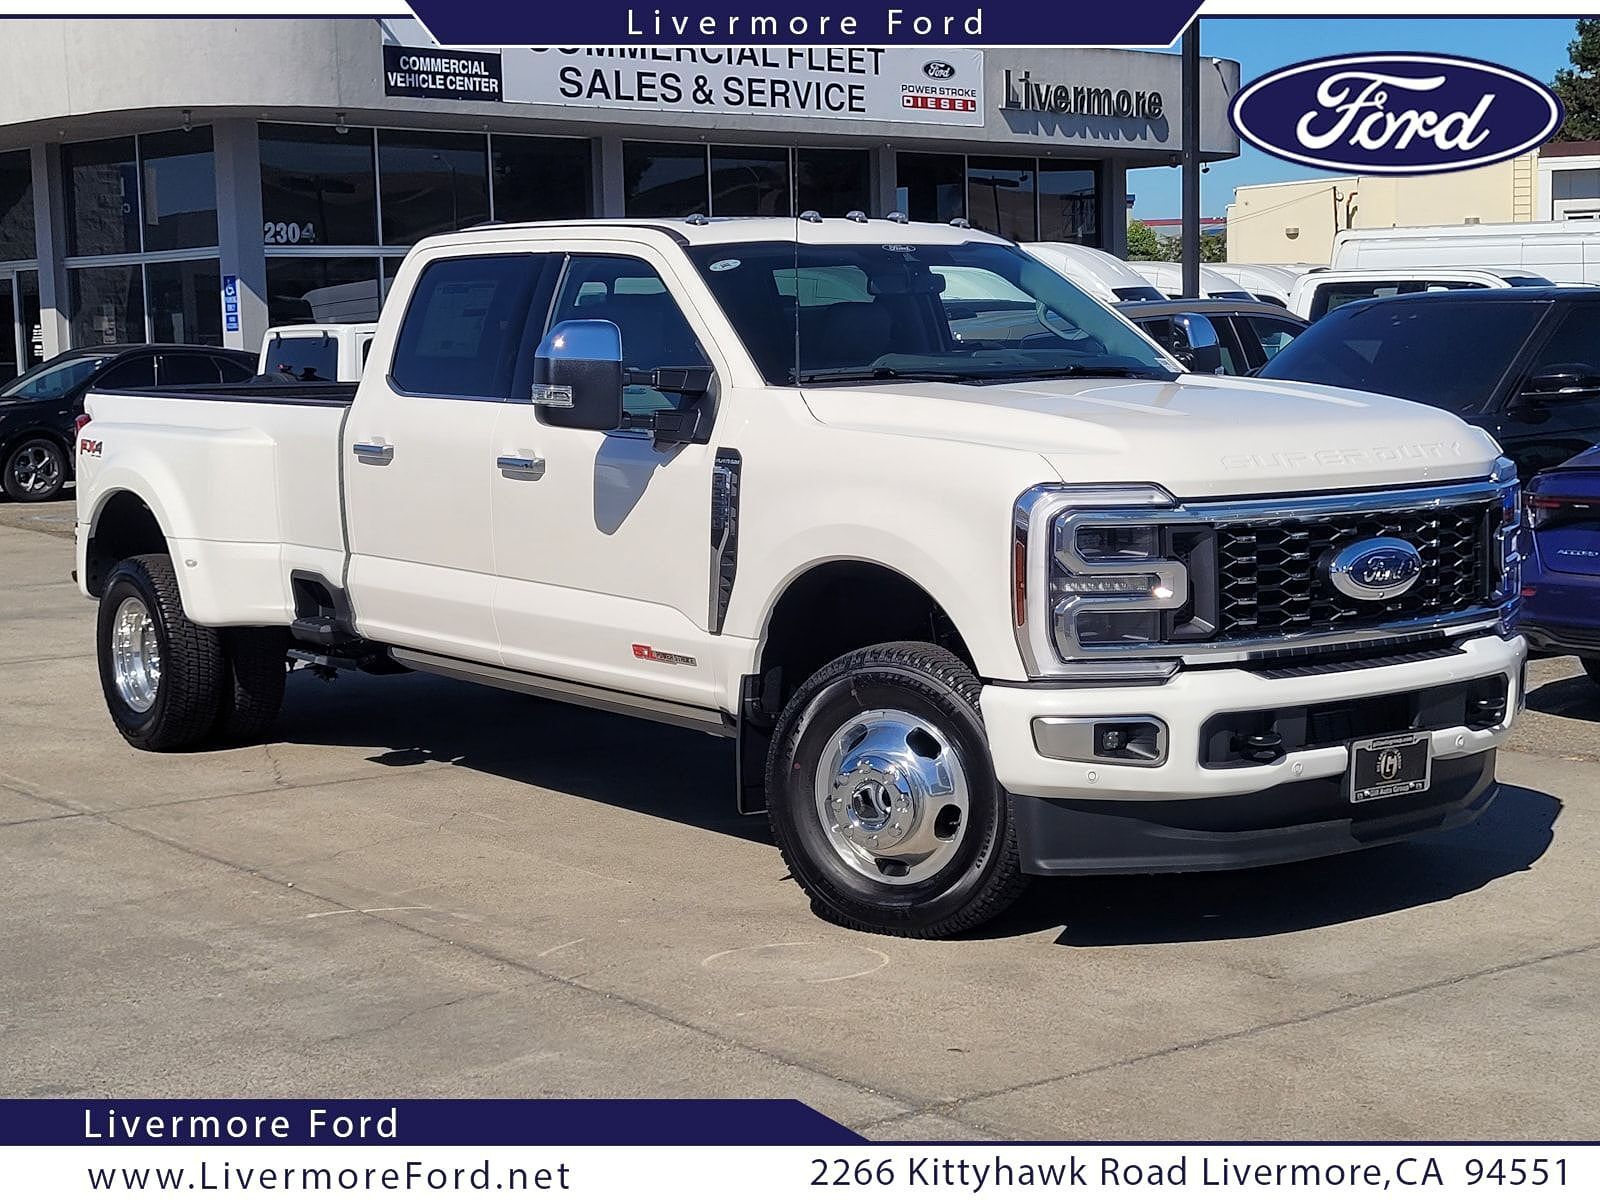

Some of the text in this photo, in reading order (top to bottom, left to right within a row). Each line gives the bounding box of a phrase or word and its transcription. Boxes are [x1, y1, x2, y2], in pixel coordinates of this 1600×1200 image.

[400, 56, 489, 76] COMMERCIAL
[530, 47, 886, 76] RCIAL FLEET
[927, 62, 951, 78] Ford
[387, 72, 499, 93] VEHICLE CENTER
[559, 66, 866, 112] SALES & SERVICE
[901, 84, 977, 98] POWER STROKE
[902, 96, 976, 112] DIESEL
[1002, 69, 1164, 119] Livermore
[264, 222, 315, 243] 2304
